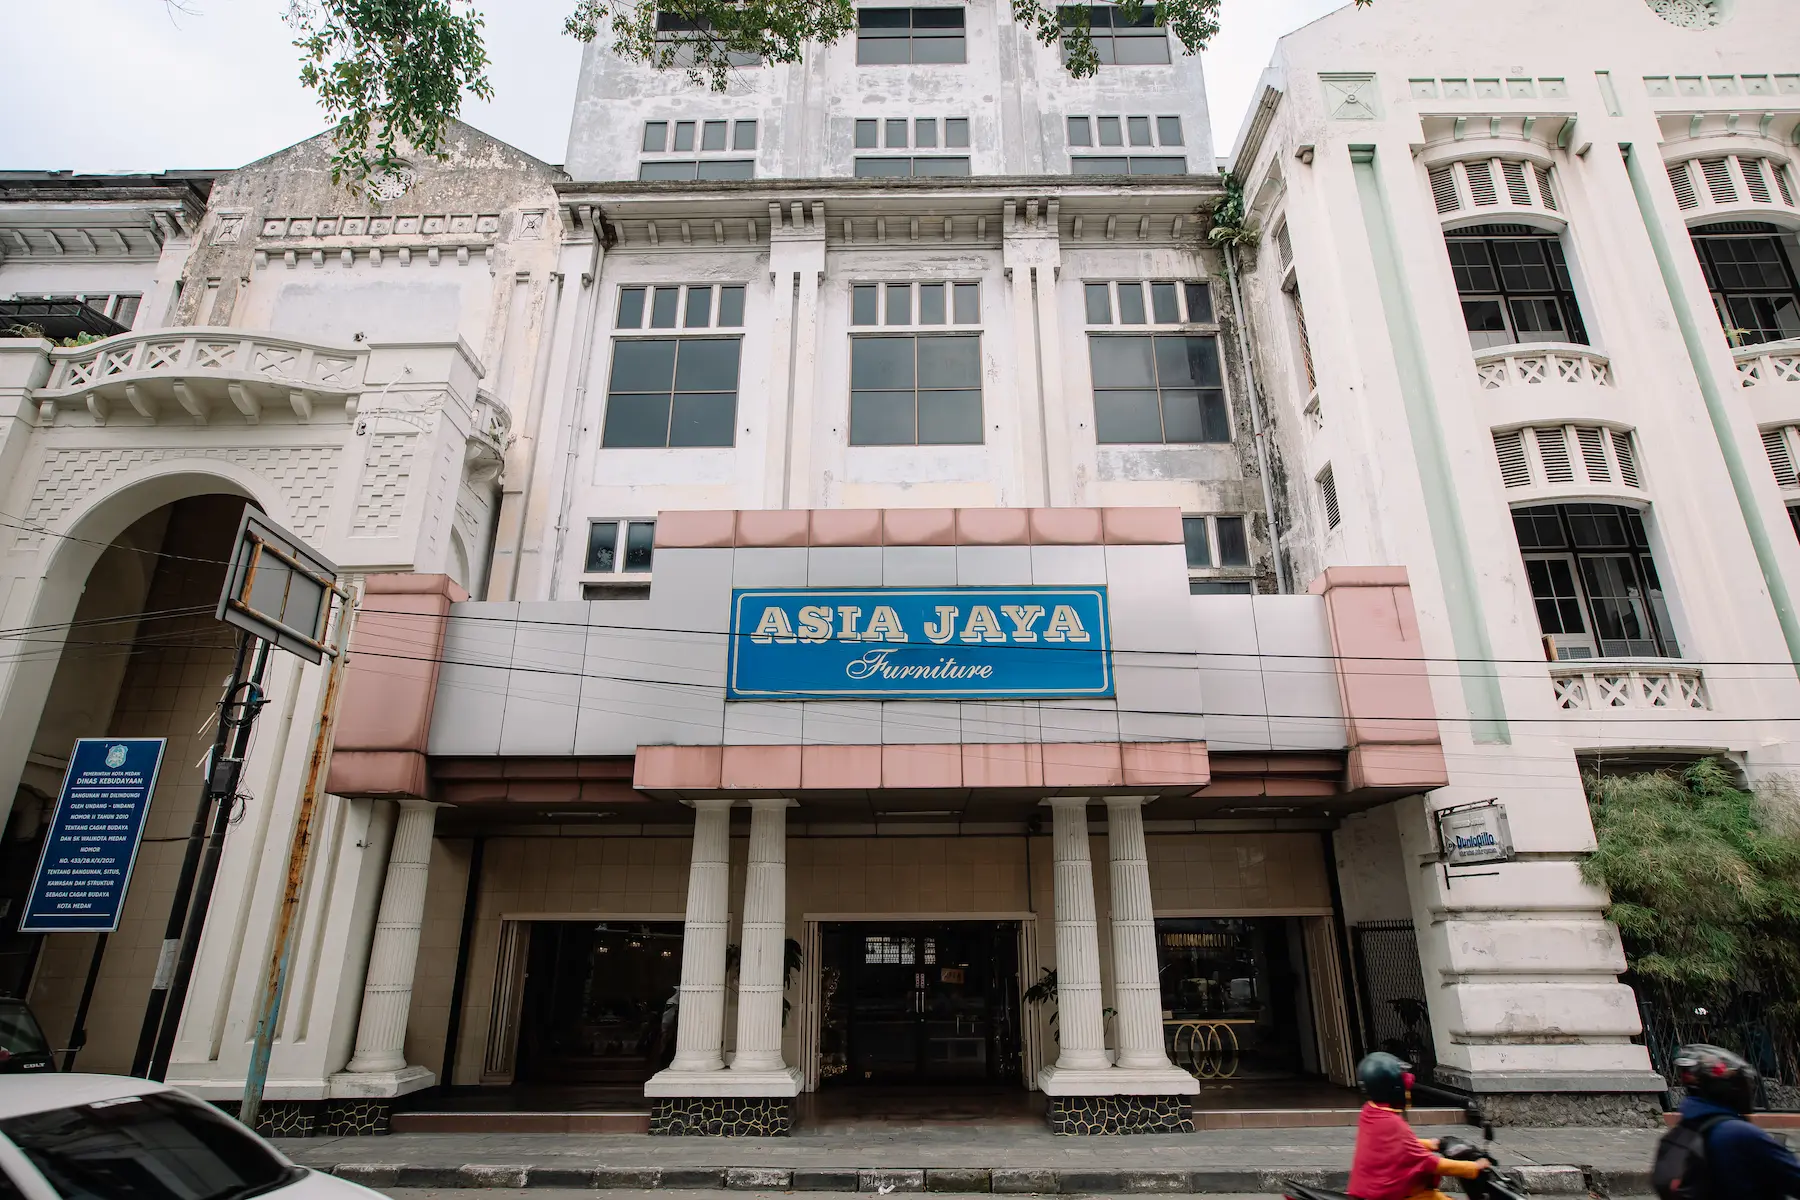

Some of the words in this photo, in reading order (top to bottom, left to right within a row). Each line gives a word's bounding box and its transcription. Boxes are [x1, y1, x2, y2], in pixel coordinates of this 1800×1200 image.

[751, 605, 908, 644] ASIA
[923, 605, 1090, 644] JAYA
[846, 648, 993, 680] Furniture
[1456, 832, 1496, 849] Dunlopillo
